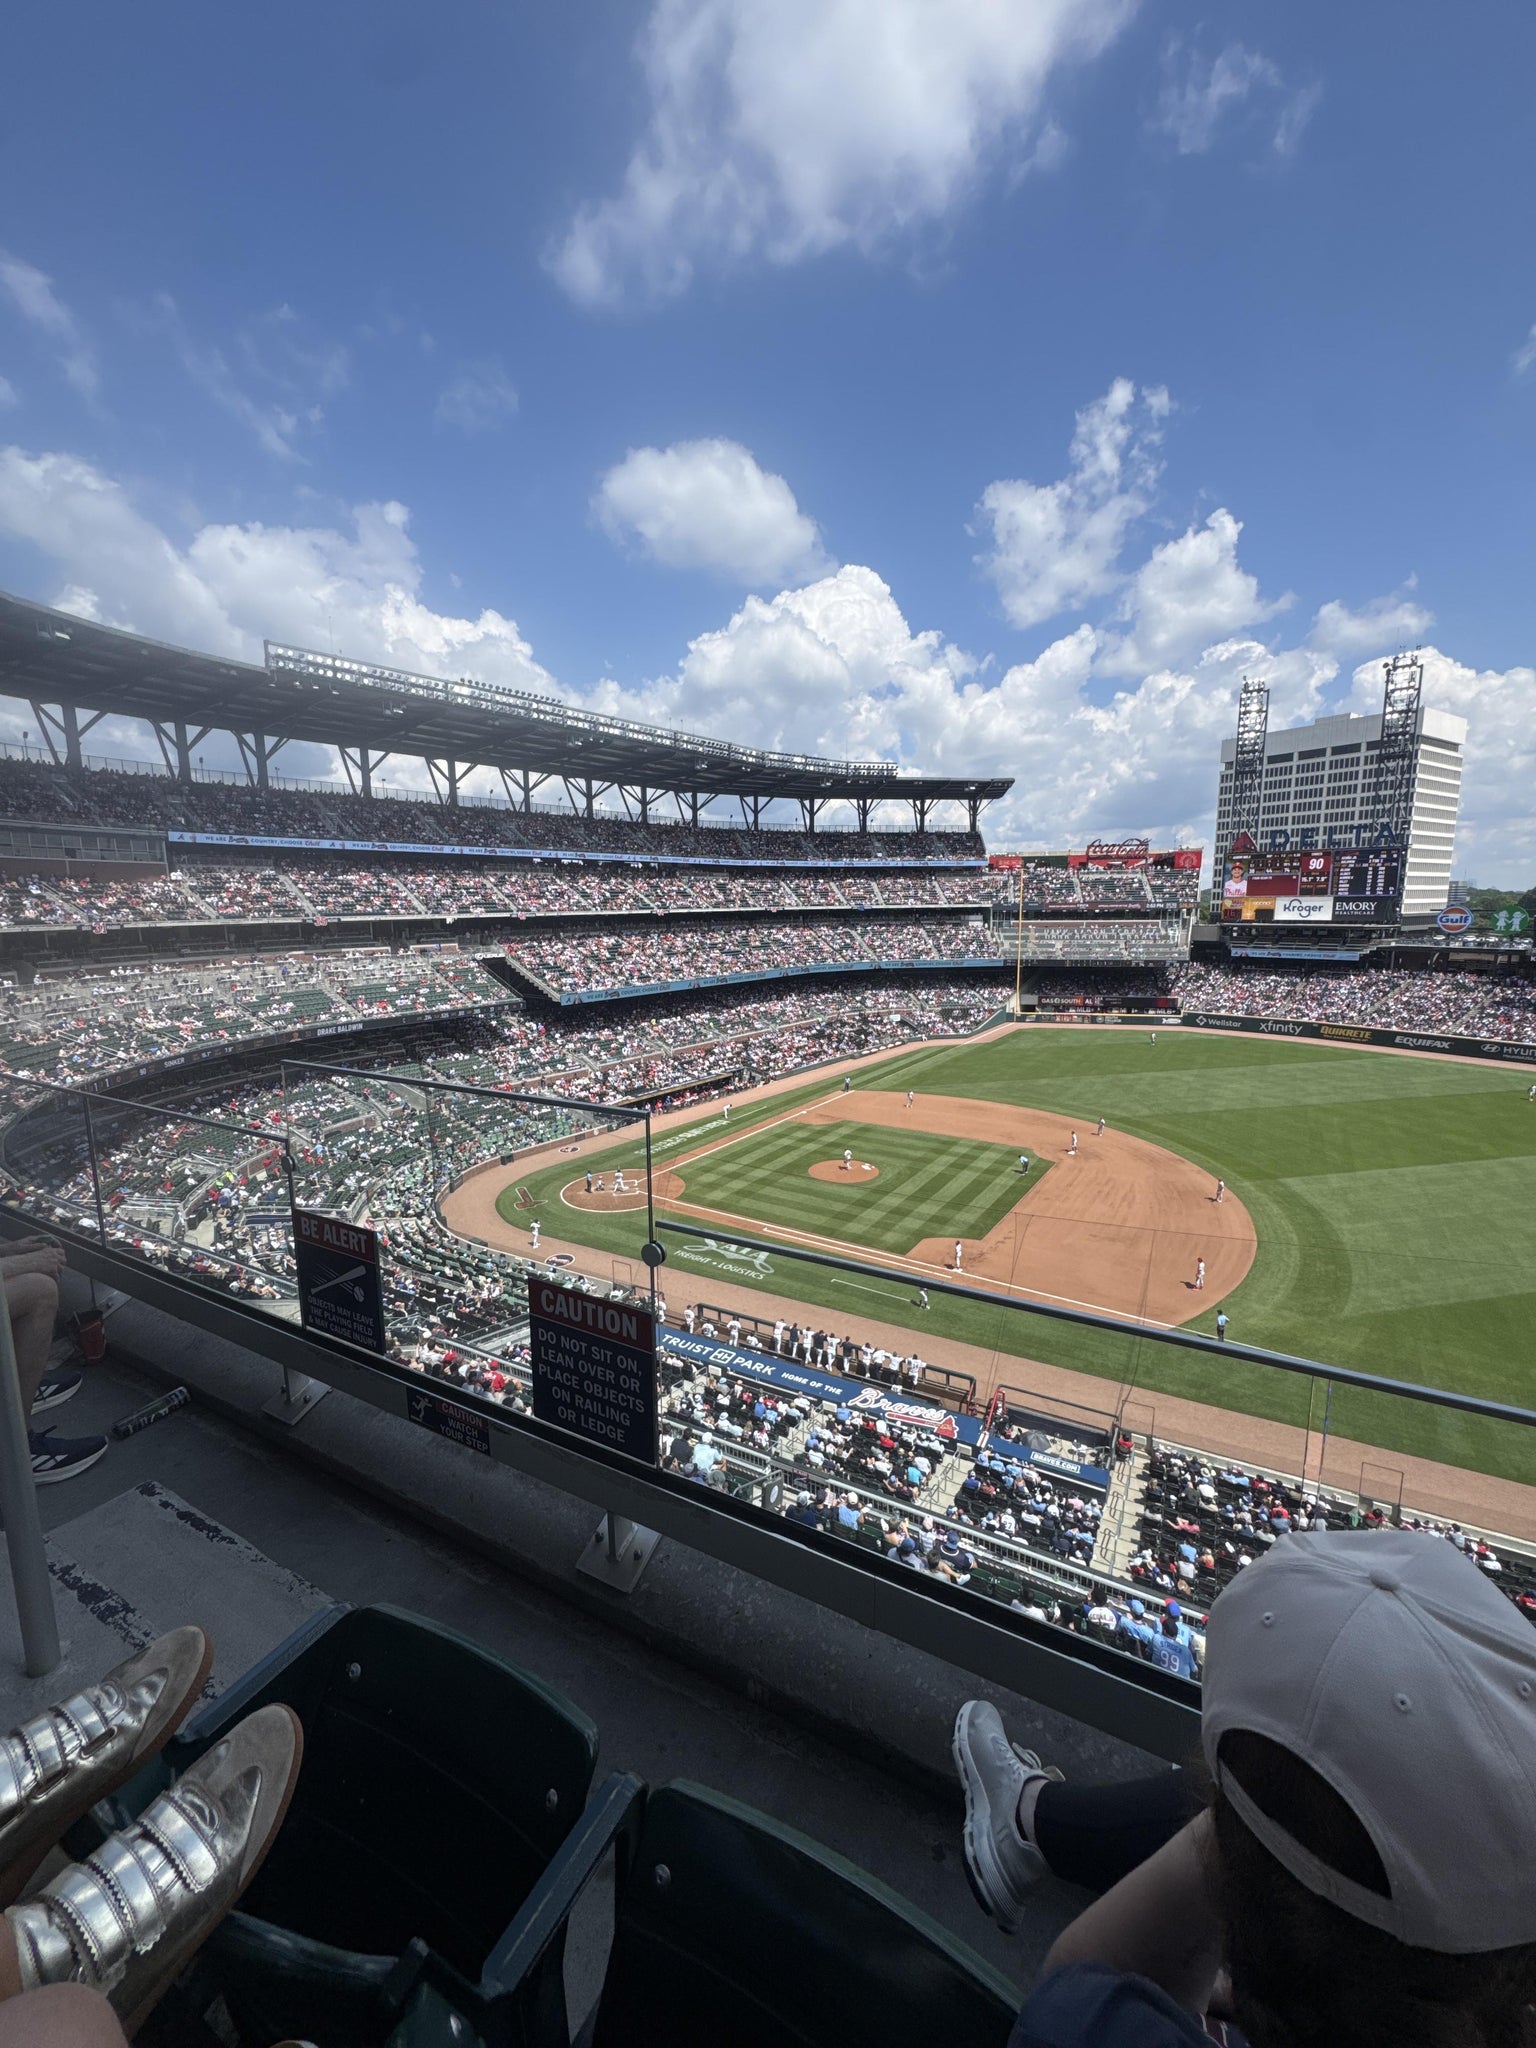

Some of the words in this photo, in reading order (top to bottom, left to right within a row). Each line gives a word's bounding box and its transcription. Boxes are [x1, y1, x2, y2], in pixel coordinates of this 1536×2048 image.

[1270, 824, 1398, 850] DELTA
[1308, 858, 1324, 870] 90
[1284, 899, 1324, 918] Kroger
[1335, 902, 1378, 910] EMORY
[1438, 915, 1470, 924] Gulf
[317, 1026, 336, 1036] DRAKE
[338, 1023, 363, 1033] BALDWIN
[1208, 1018, 1242, 1028] Wellstar
[1260, 1020, 1303, 1035] xfinity
[1320, 1026, 1372, 1038] QUIKRETE
[1394, 1036, 1450, 1049] EQUIFAX
[164, 1058, 185, 1068] SINKER
[300, 1216, 320, 1240] BE
[324, 1223, 367, 1254] ALERT
[674, 1250, 712, 1264] FREIGHT
[718, 1262, 766, 1280] LOGISTICS
[308, 1296, 336, 1311] OBJECTS
[336, 1306, 351, 1318] MAY
[352, 1310, 375, 1326] LEAVE
[310, 1306, 322, 1316] THE
[324, 1310, 352, 1328] PLAYING
[354, 1320, 372, 1335] FIELD
[540, 1288, 638, 1340] CAUTION
[314, 1316, 328, 1329] MAY
[330, 1322, 352, 1338] CAUSE
[352, 1332, 377, 1348] INJURY
[538, 1328, 556, 1345] DO
[561, 1336, 587, 1356] NOT
[592, 1346, 613, 1364] SIT
[616, 1354, 643, 1378] ON,
[661, 1334, 714, 1356] TRUIST
[732, 1356, 777, 1376] PARK
[781, 1372, 809, 1384] HOME
[810, 1380, 822, 1388] OF
[824, 1384, 844, 1395] THE
[541, 1346, 574, 1370] LEAN
[578, 1360, 616, 1384] OVER
[620, 1374, 640, 1394] OR
[538, 1364, 580, 1390] PLACE
[584, 1380, 645, 1414] OBJECTS
[442, 1402, 482, 1427] CAUTION
[552, 1386, 570, 1404] ON
[575, 1396, 631, 1427] RAILING
[848, 1388, 946, 1421] Braves
[448, 1418, 478, 1438] WATCH
[558, 1406, 577, 1424] OR
[580, 1414, 626, 1443] LEDGE
[440, 1424, 464, 1442] YOUR
[466, 1436, 488, 1452] STEP
[1034, 1453, 1078, 1471] BRAVES.COM
[1160, 1650, 1180, 1672] 99
